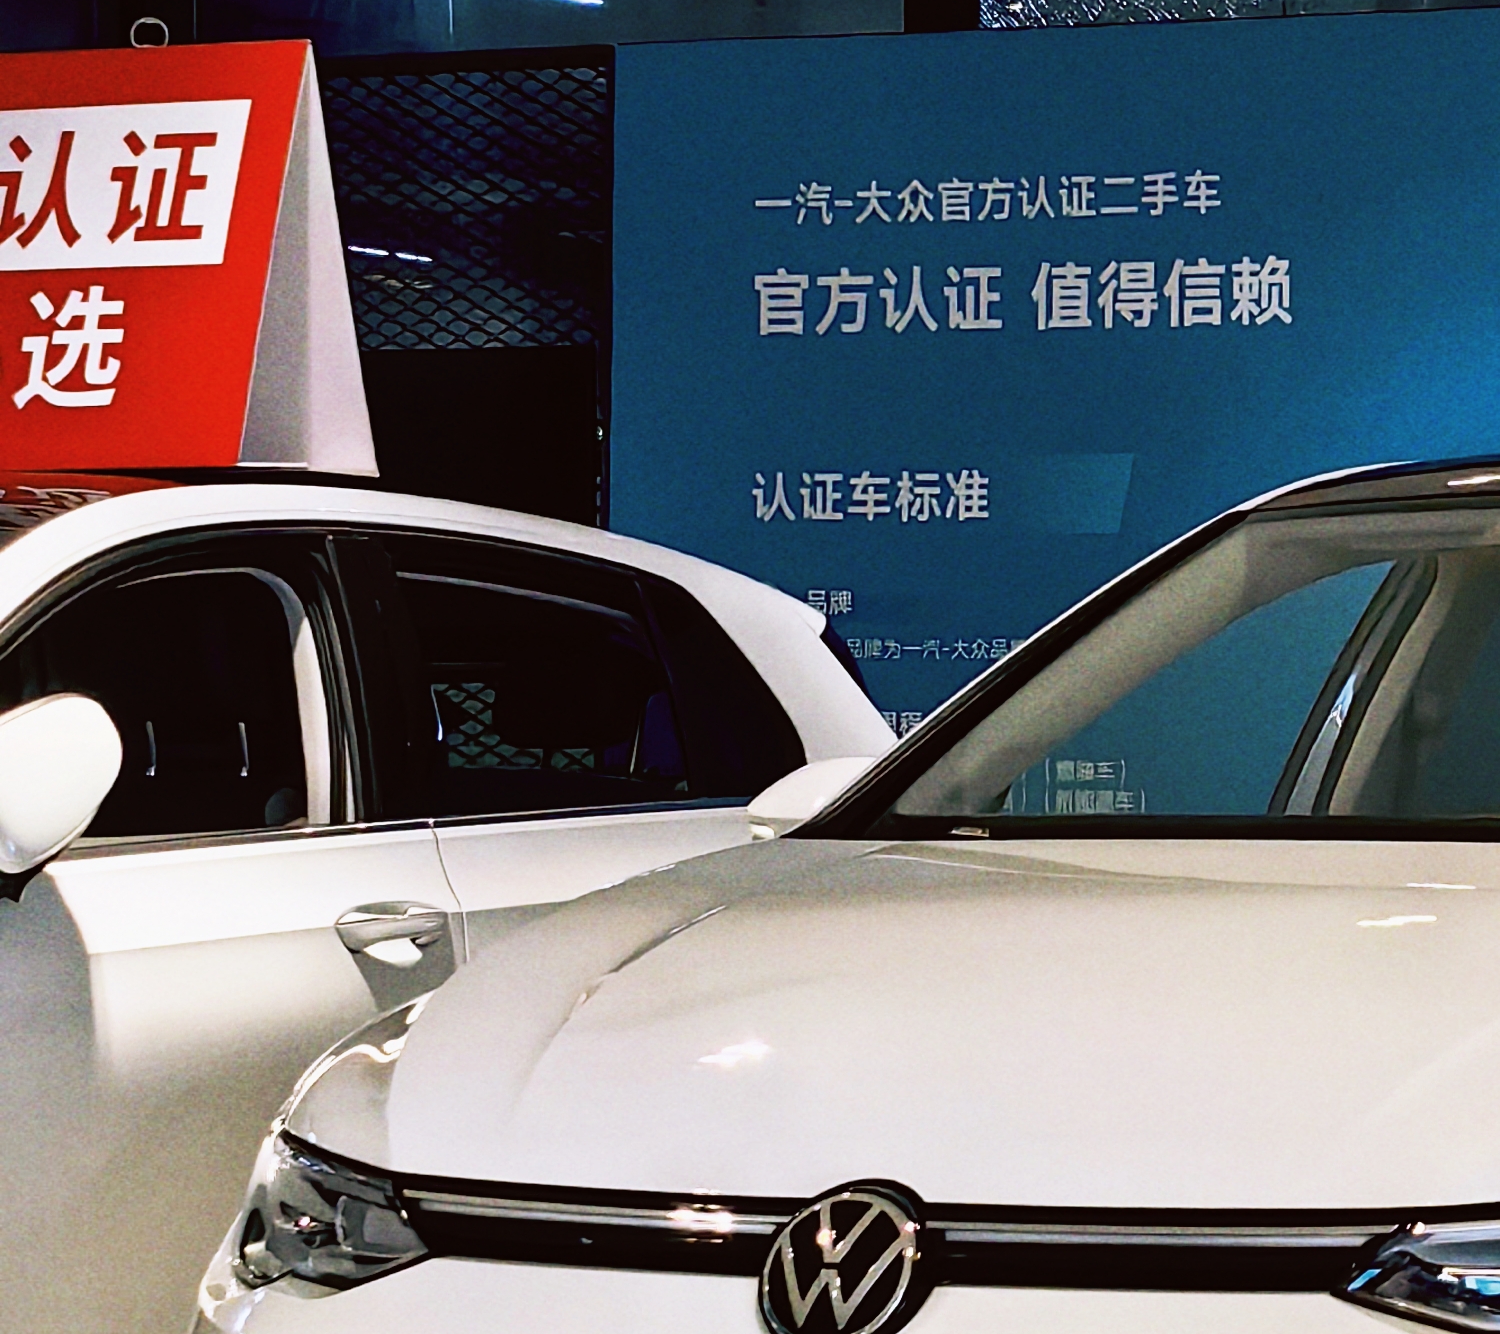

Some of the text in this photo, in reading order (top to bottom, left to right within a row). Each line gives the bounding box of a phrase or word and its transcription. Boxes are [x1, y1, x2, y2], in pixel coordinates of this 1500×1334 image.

[0, 130, 217, 249] 认证
[754, 169, 1222, 225] 一汽-大众官方认证二手车
[753, 254, 1294, 337] 官方认证 值得信赖
[11, 285, 125, 410] 选
[752, 469, 990, 523] 认证车标准
